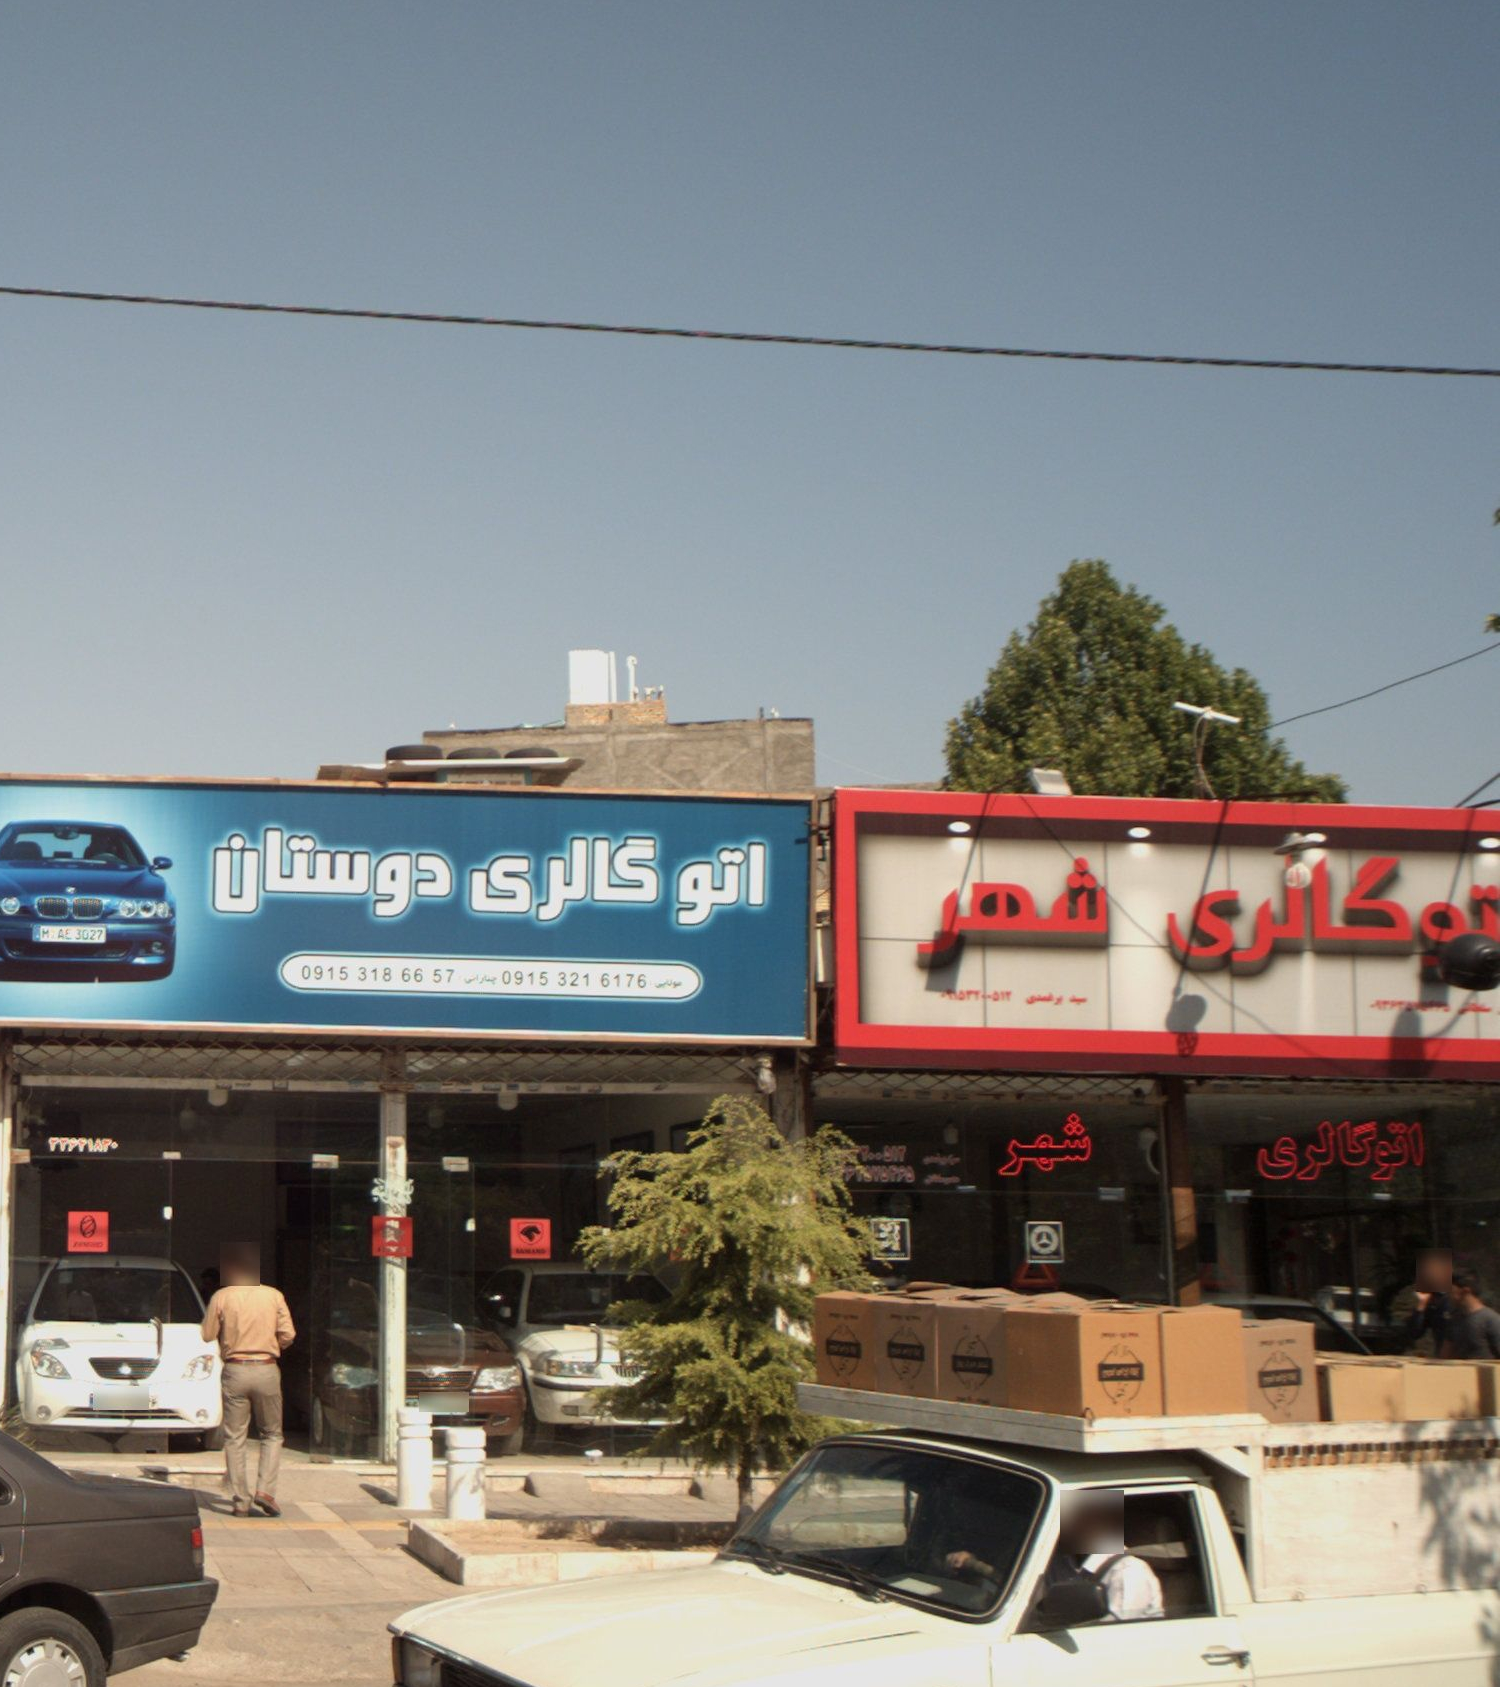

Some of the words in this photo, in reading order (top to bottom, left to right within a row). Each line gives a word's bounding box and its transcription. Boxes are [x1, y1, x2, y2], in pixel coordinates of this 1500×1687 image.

[213, 827, 453, 918] دوستان
[468, 836, 660, 922] گالری
[676, 840, 767, 926] اتو
[916, 857, 1109, 958] شهر
[301, 965, 349, 980] 0915
[358, 966, 392, 982] 318
[401, 967, 424, 983] 66
[432, 968, 455, 984] 57
[502, 970, 549, 986] 0915
[558, 972, 590, 987] 321
[601, 973, 648, 988] 6176
[998, 1112, 1093, 1177] شهر
